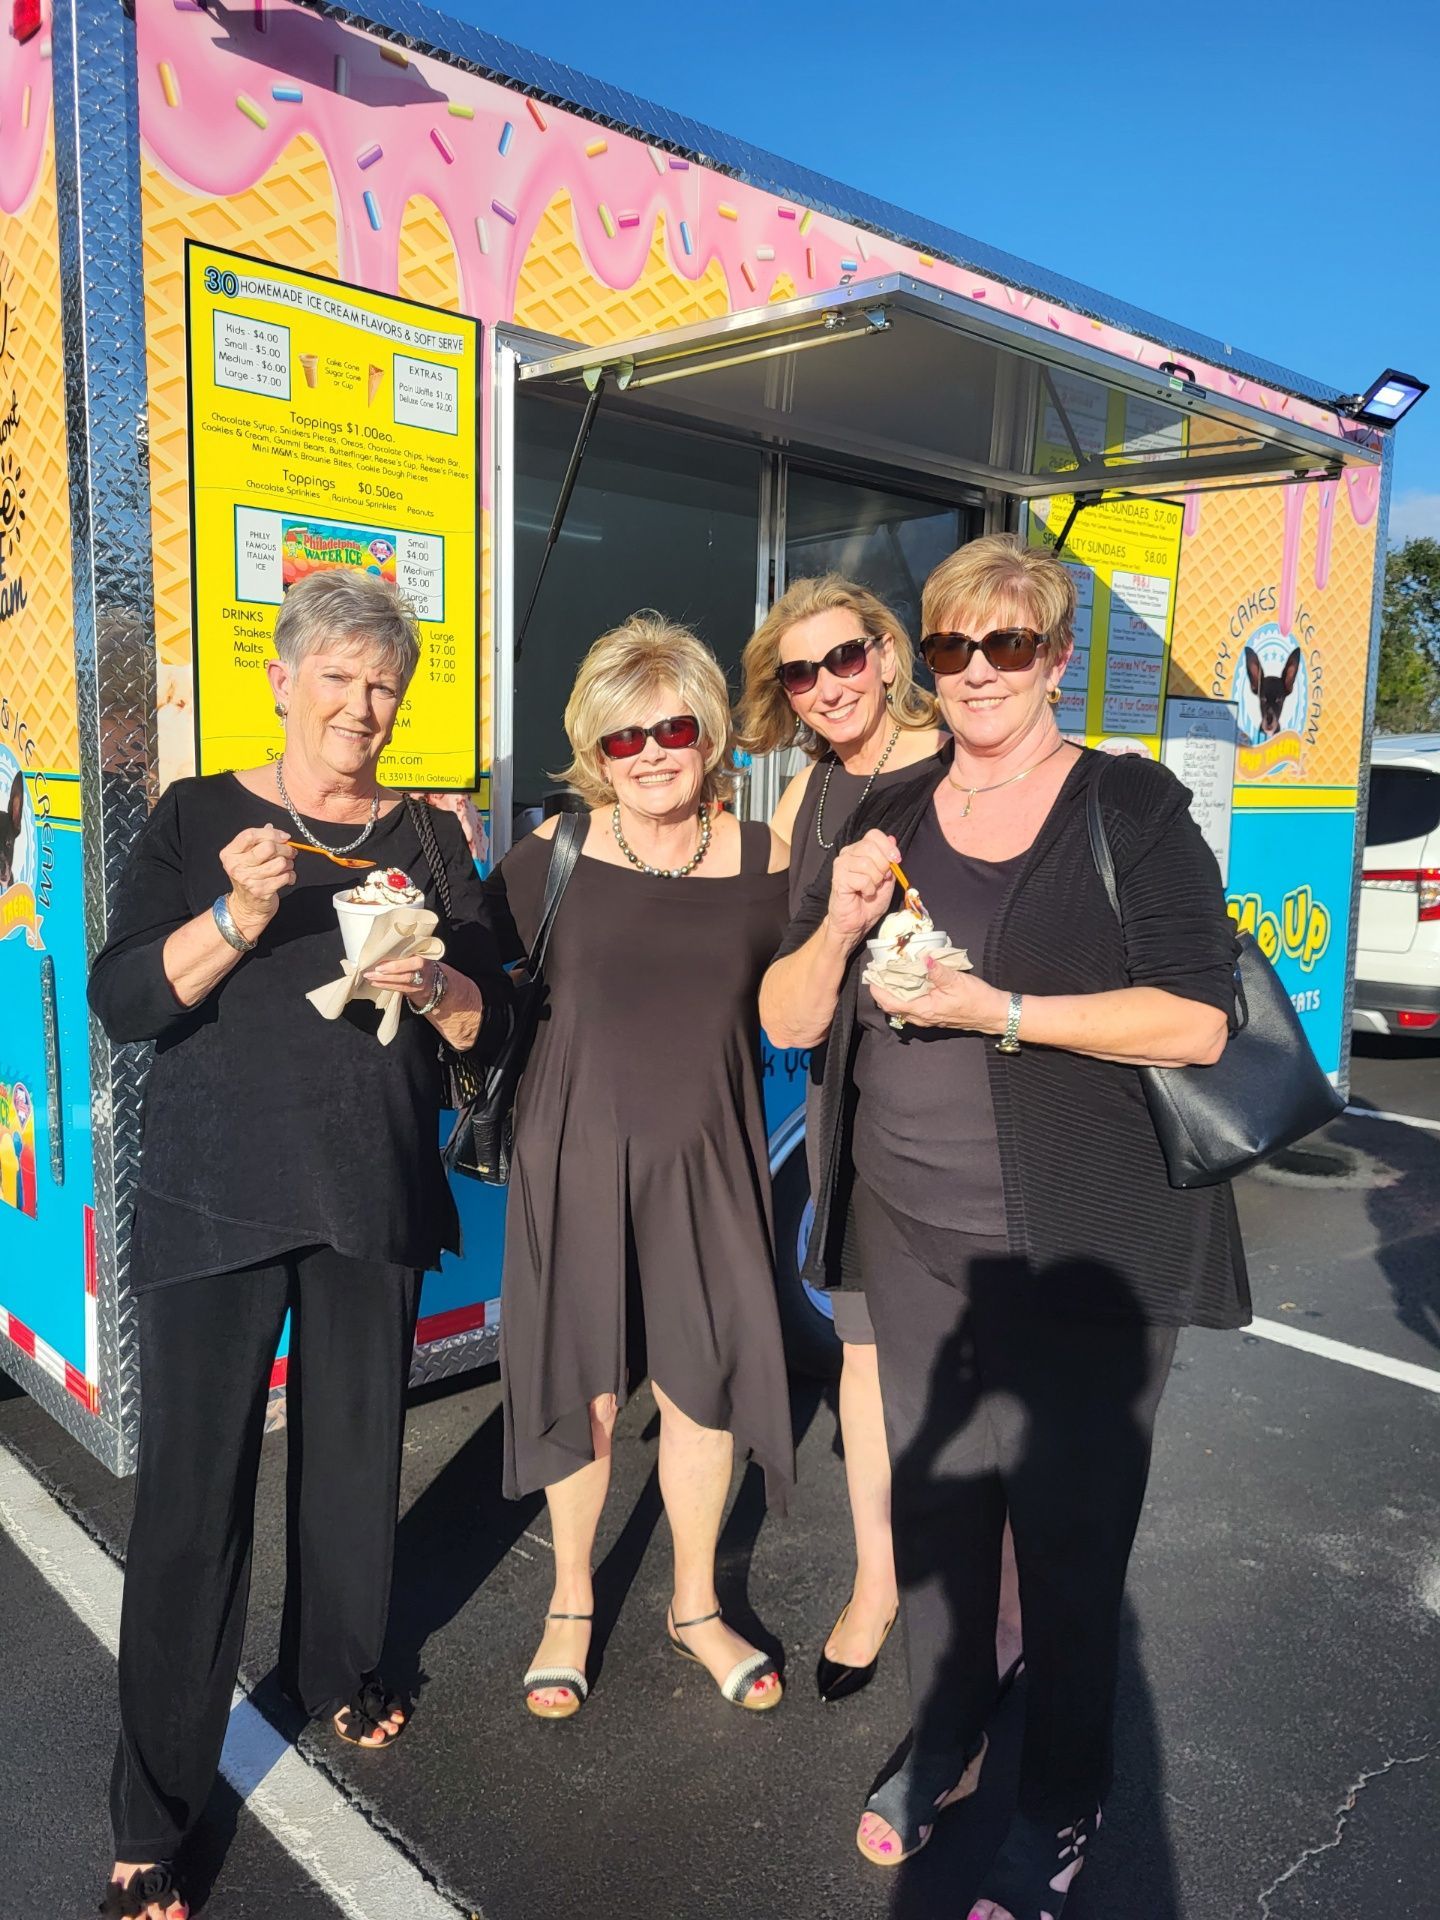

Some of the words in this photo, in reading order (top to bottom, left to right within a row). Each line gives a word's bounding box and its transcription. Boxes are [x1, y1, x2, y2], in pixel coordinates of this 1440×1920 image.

[204, 266, 239, 298] 30
[240, 281, 303, 304] HOMEMADE
[307, 294, 322, 310] ICE
[324, 301, 360, 324] CREAM
[361, 314, 403, 339] FLAVORS
[404, 329, 411, 341] &
[414, 331, 437, 347] SOFT
[438, 337, 463, 351] SERVE
[226, 323, 246, 336] Kids
[253, 329, 279, 344] $4.00
[224, 337, 248, 351] Small
[256, 344, 281, 359] $5.00
[218, 351, 254, 367] Medium
[261, 360, 287, 374] $6.00
[344, 361, 360, 372] Cone
[224, 367, 249, 381] Large
[256, 373, 282, 388] $7.00
[325, 366, 344, 378] Sugar
[345, 372, 362, 382] Cone
[409, 365, 443, 382] EXTRAS
[341, 381, 354, 390] Cup
[414, 386, 434, 398] Waffle
[436, 390, 453, 402] $1.00
[419, 398, 434, 409] Cone
[436, 401, 453, 413] $2.00
[290, 411, 343, 434] Toppings
[346, 422, 396, 443] $1.00ea.
[211, 412, 251, 427] Chocolate
[253, 420, 278, 434] Syrup,
[280, 425, 311, 439] Snickers
[312, 432, 339, 445] Pieces,
[367, 442, 402, 456] Chocolate
[403, 450, 424, 461] Chips,
[426, 454, 447, 465] Heath
[201, 422, 234, 436] Cookies
[235, 428, 243, 437] &
[244, 430, 272, 443] Cream,
[273, 436, 301, 448] Gummi
[303, 441, 327, 453] Bears,
[374, 455, 402, 467] Reese's
[420, 463, 447, 475] Reese's
[447, 468, 470, 480] Pieces
[252, 443, 269, 453] Mini
[300, 452, 332, 465] Brownie
[356, 462, 381, 474] Cookie
[382, 467, 405, 479] Dough
[406, 471, 429, 483] Pieces
[282, 469, 336, 491] Toppings
[358, 481, 404, 501] $0.50ea
[246, 479, 285, 493] Chocolate
[286, 485, 321, 499] Sprinkles
[331, 493, 364, 506] Rainbow
[365, 499, 397, 512] Sprinkles
[407, 505, 435, 518] Peanuts
[1111, 502, 1149, 520] SUNDAES
[1154, 511, 1178, 526] $7.00
[249, 530, 271, 540] PHILLY
[303, 533, 361, 551] Philadelphia
[245, 541, 277, 552] FAMOUS
[407, 538, 429, 549] Small
[1042, 532, 1087, 552] SPEALTY
[1087, 540, 1126, 558] SUNDAES
[1144, 550, 1168, 565] $8.00
[246, 551, 275, 562] ITALIAN
[304, 547, 344, 563] WATER
[344, 549, 363, 566] ICE
[406, 550, 429, 561] $4.00
[255, 562, 267, 571] ICE
[403, 565, 435, 577] Medium
[407, 577, 430, 588] $5.00
[406, 592, 428, 604] Large
[222, 608, 264, 623] DRINKS
[233, 626, 272, 639] Shakes
[429, 630, 455, 644] Large
[233, 641, 264, 654] Malts
[429, 657, 456, 670] $7.00
[429, 643, 456, 656] $7.00
[234, 656, 260, 669] Root
[1230, 586, 1277, 639] CAKES
[1295, 603, 1315, 645] ICE
[1305, 650, 1324, 746] CREAM
[429, 671, 456, 684] $7.00
[378, 754, 423, 765] am.com
[388, 773, 413, 782] 33913
[427, 774, 462, 784] Gateway)
[14, 711, 36, 767] ICE
[34, 771, 55, 908] CREAM
[1282, 884, 1331, 973] Up
